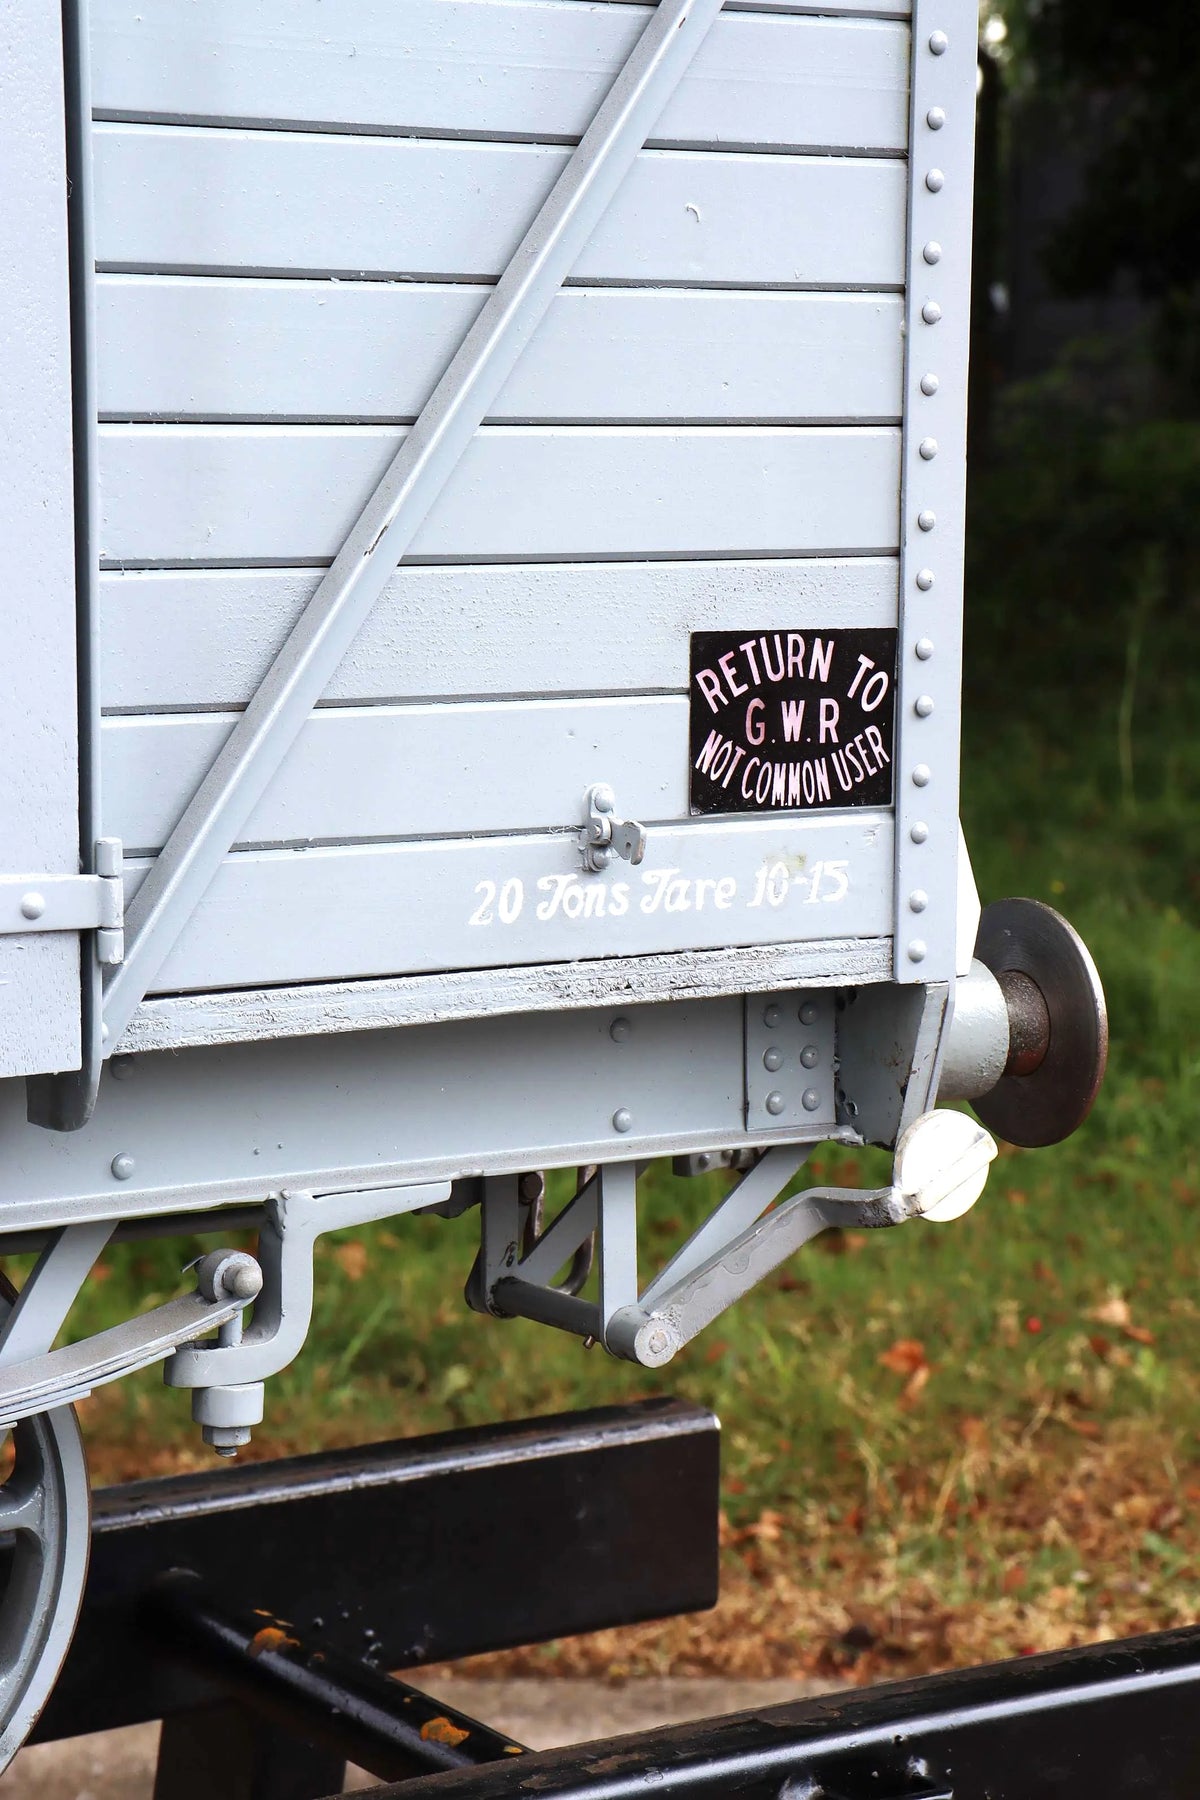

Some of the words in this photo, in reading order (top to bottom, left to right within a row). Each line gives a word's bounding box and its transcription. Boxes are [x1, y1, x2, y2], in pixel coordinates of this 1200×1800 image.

[695, 633, 835, 714] RETURN
[847, 654, 889, 712] TO
[745, 697, 840, 746] G.W.R
[695, 729, 746, 789] NOT
[741, 756, 831, 807] COMMON
[831, 725, 890, 792] USER
[468, 877, 524, 926] 20
[536, 873, 631, 921] Tons
[640, 868, 737, 914] Tare
[746, 860, 849, 908] 10-15
